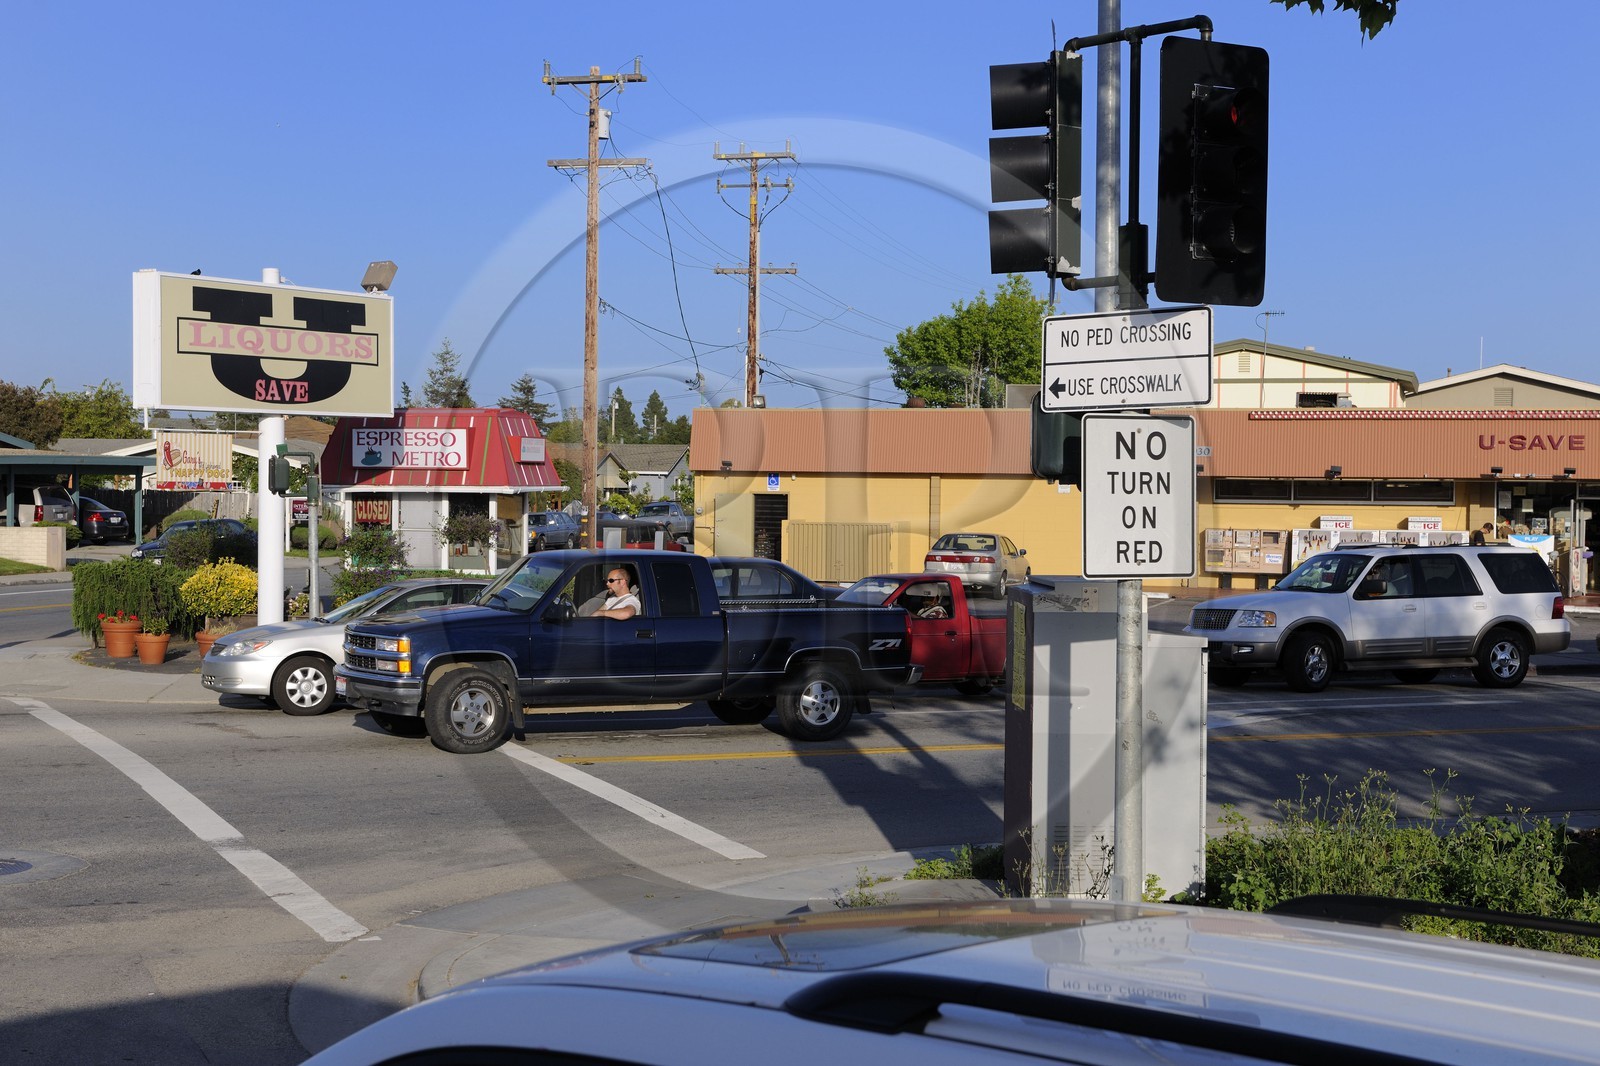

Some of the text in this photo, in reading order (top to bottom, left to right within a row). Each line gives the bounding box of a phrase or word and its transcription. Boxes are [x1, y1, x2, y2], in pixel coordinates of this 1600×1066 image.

[188, 322, 373, 359] LIQUORS
[1061, 322, 1192, 348] NO PED CROSSING
[255, 378, 309, 402] SAVE
[1068, 374, 1183, 396] USE CROSSWALK
[356, 431, 457, 447] ESPRESSO
[1115, 431, 1167, 460] NO
[1479, 435, 1585, 450] U-SAVE
[392, 451, 462, 466] METRO
[1196, 447, 1210, 455] 30
[207, 468, 230, 478] DOGS
[1107, 471, 1171, 495] TURN
[356, 500, 390, 520] CLOSED
[1122, 505, 1157, 529] ON
[1116, 541, 1163, 564] RED
[869, 639, 902, 650] Z71
